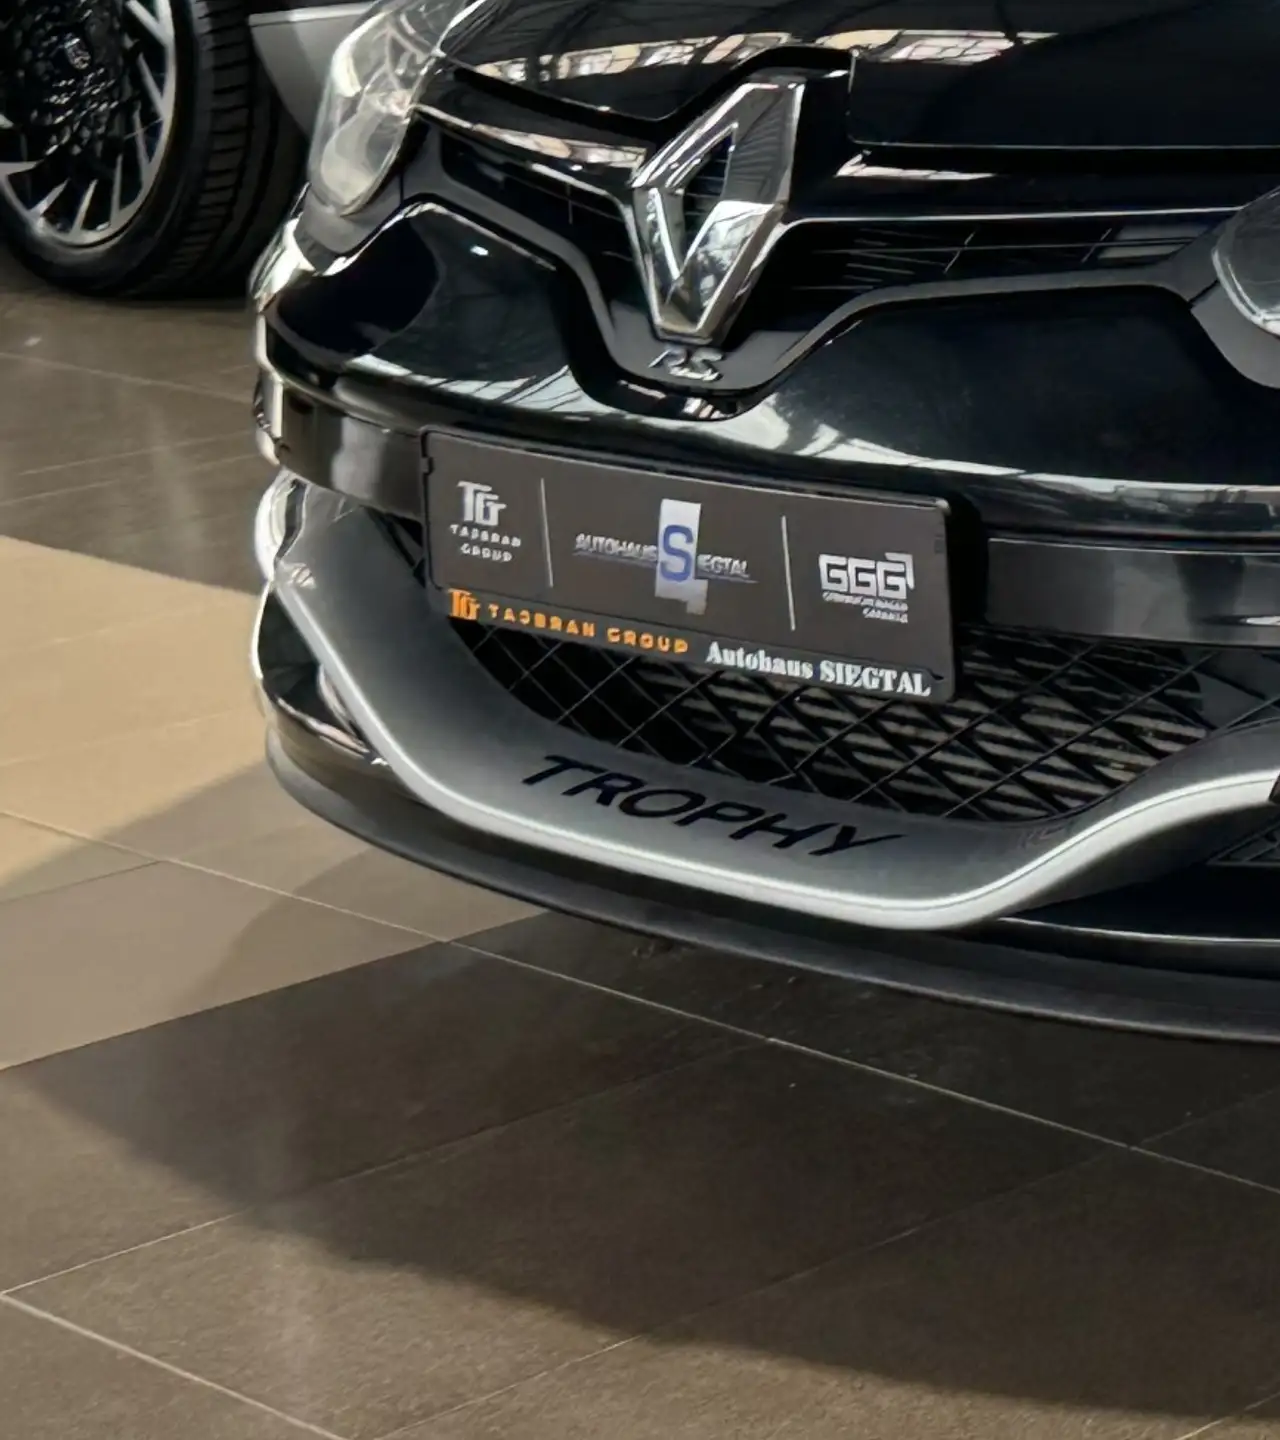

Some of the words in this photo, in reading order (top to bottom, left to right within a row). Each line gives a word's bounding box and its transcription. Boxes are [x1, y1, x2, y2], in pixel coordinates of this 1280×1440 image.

[460, 542, 513, 563] GROUP
[575, 532, 658, 561] AUTOHAUS
[818, 552, 909, 600] GGG
[607, 626, 689, 654] GROUP
[705, 640, 814, 680] Autohaus
[819, 659, 932, 698] SIEGTAL
[521, 754, 908, 857] TROPHY
